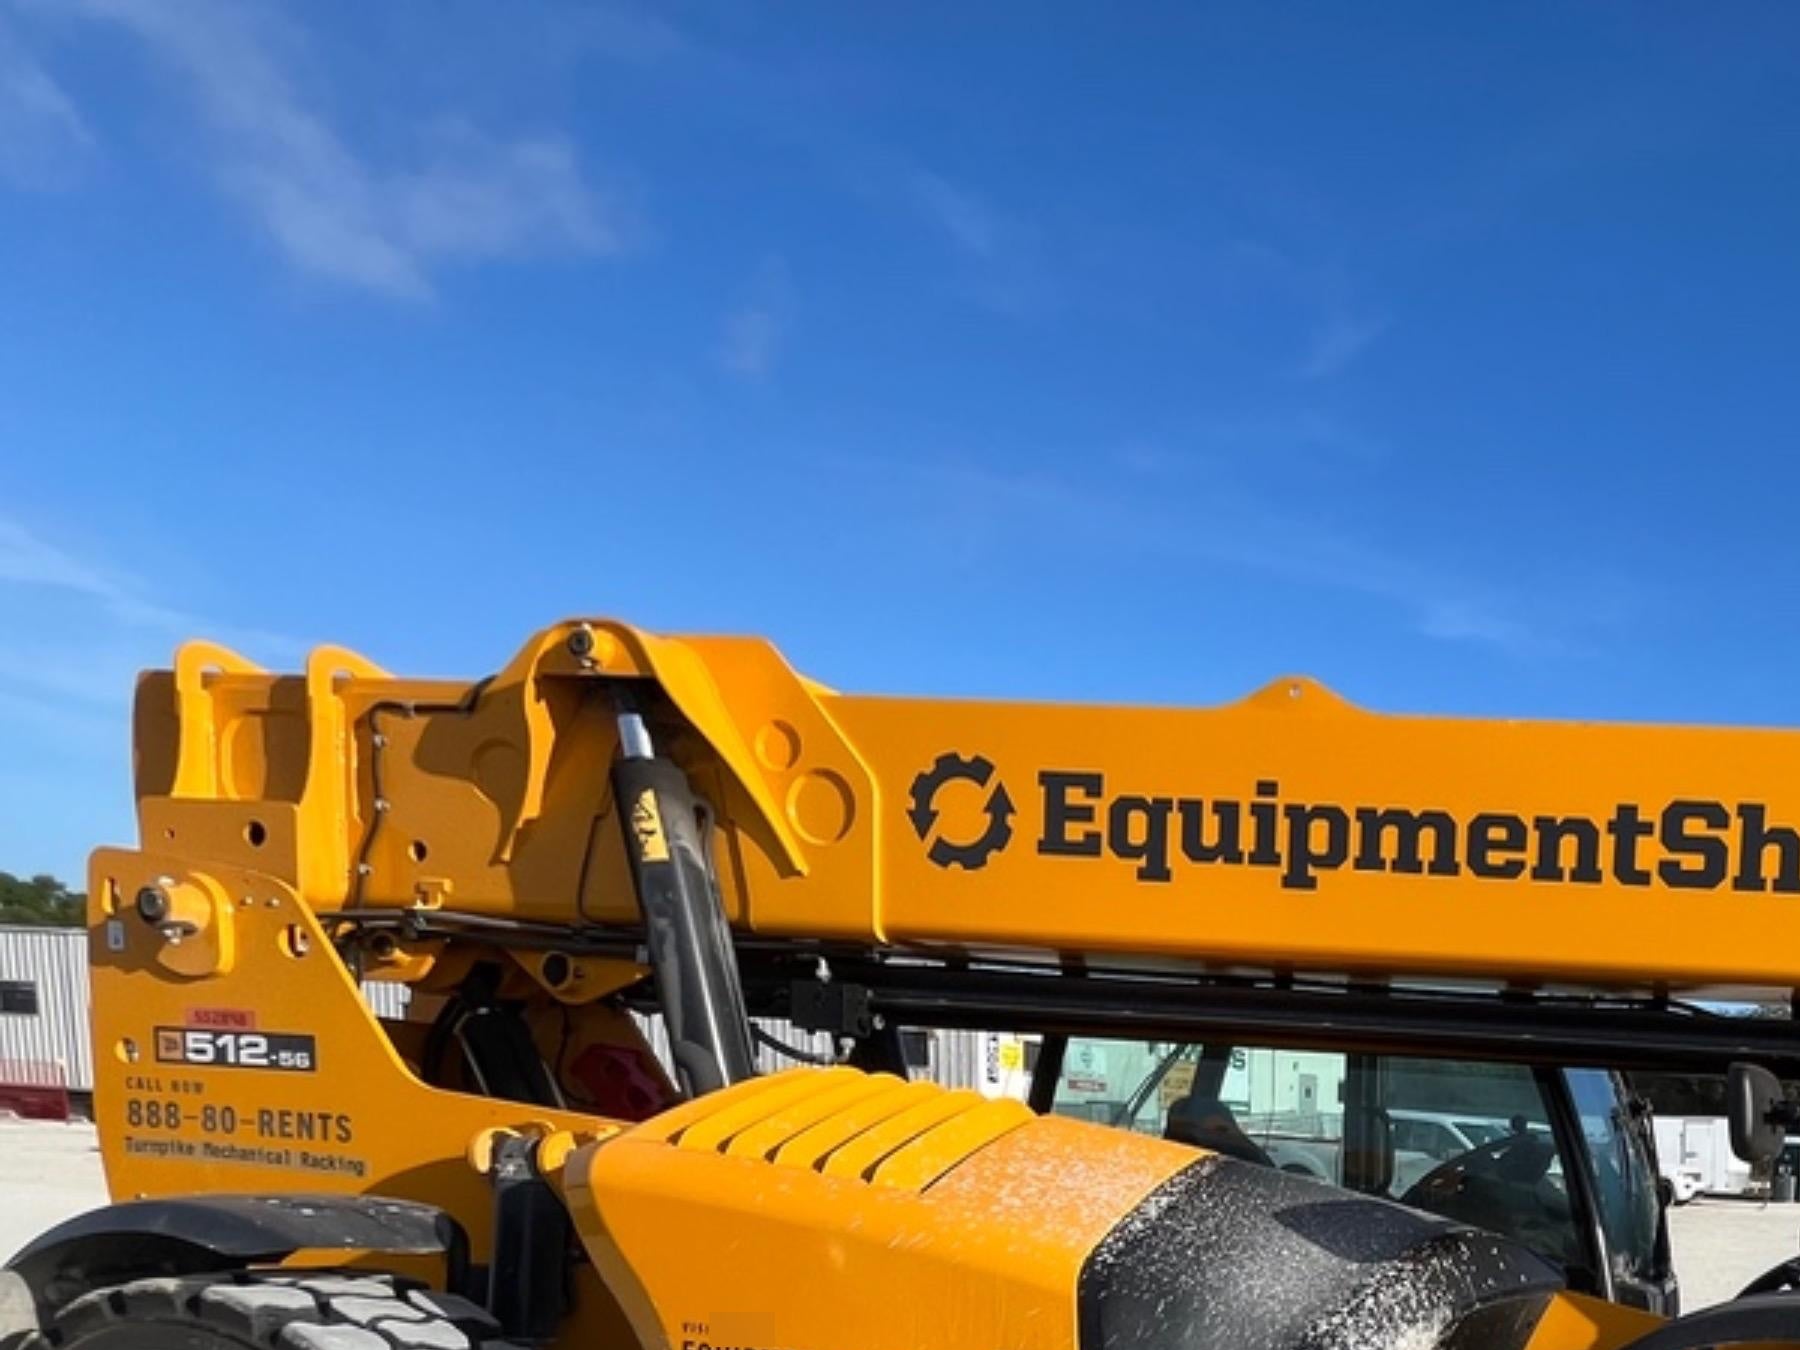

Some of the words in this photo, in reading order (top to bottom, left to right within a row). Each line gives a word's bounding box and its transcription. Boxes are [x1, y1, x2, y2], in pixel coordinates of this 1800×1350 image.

[126, 1076, 163, 1092] CALL
[126, 1099, 352, 1143] 888-80-RENTS
[124, 1136, 195, 1156] Turnpike
[202, 1142, 291, 1166] Mechanical
[300, 1150, 366, 1177] Racking
